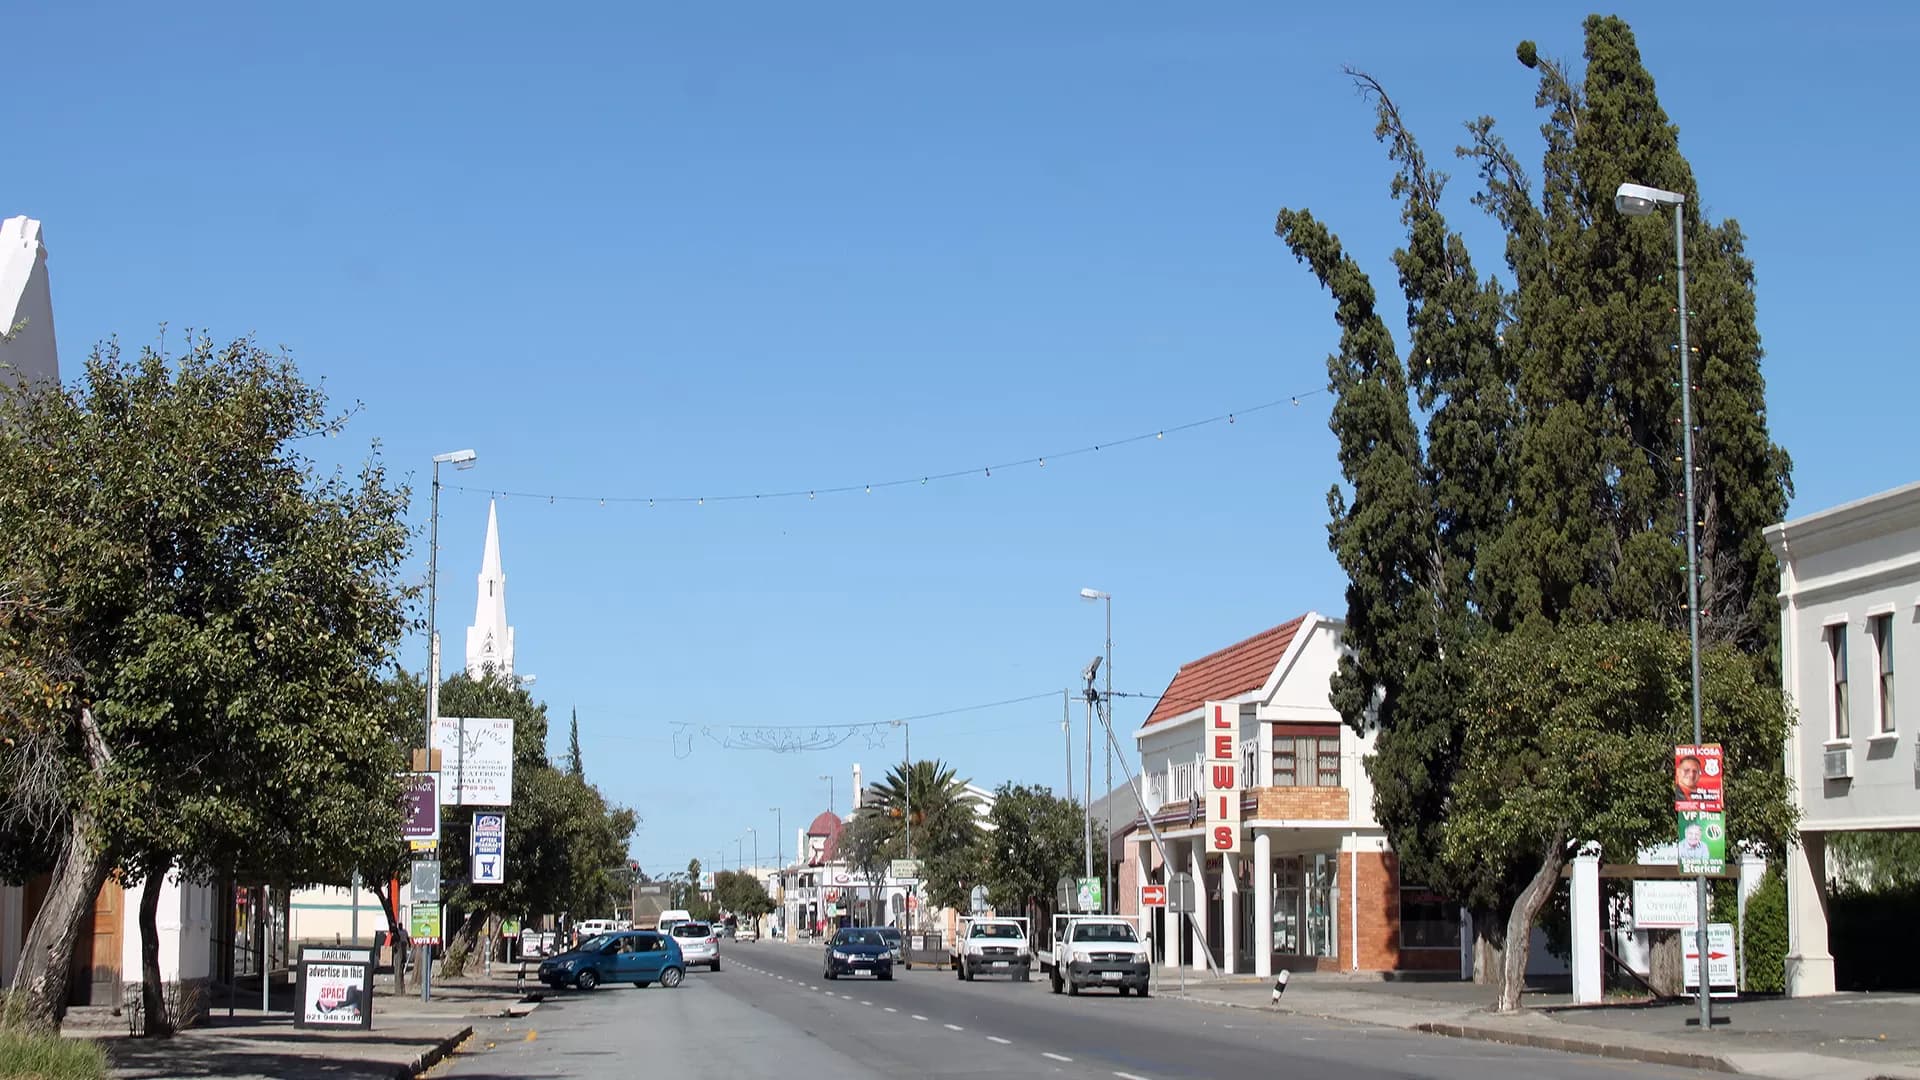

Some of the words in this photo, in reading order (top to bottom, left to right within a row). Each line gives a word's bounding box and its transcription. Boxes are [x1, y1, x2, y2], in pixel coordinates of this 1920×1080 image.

[1697, 747, 1720, 755] ICOSA
[1214, 705, 1233, 850] LEWIS
[1682, 812, 1697, 820] VF
[1700, 811, 1721, 820] Plus
[1683, 863, 1722, 873] Sterker
[321, 951, 352, 960] DARLING
[309, 965, 341, 978] advertise
[342, 966, 349, 978] in
[350, 966, 363, 979] this
[321, 987, 345, 1000] SPACE
